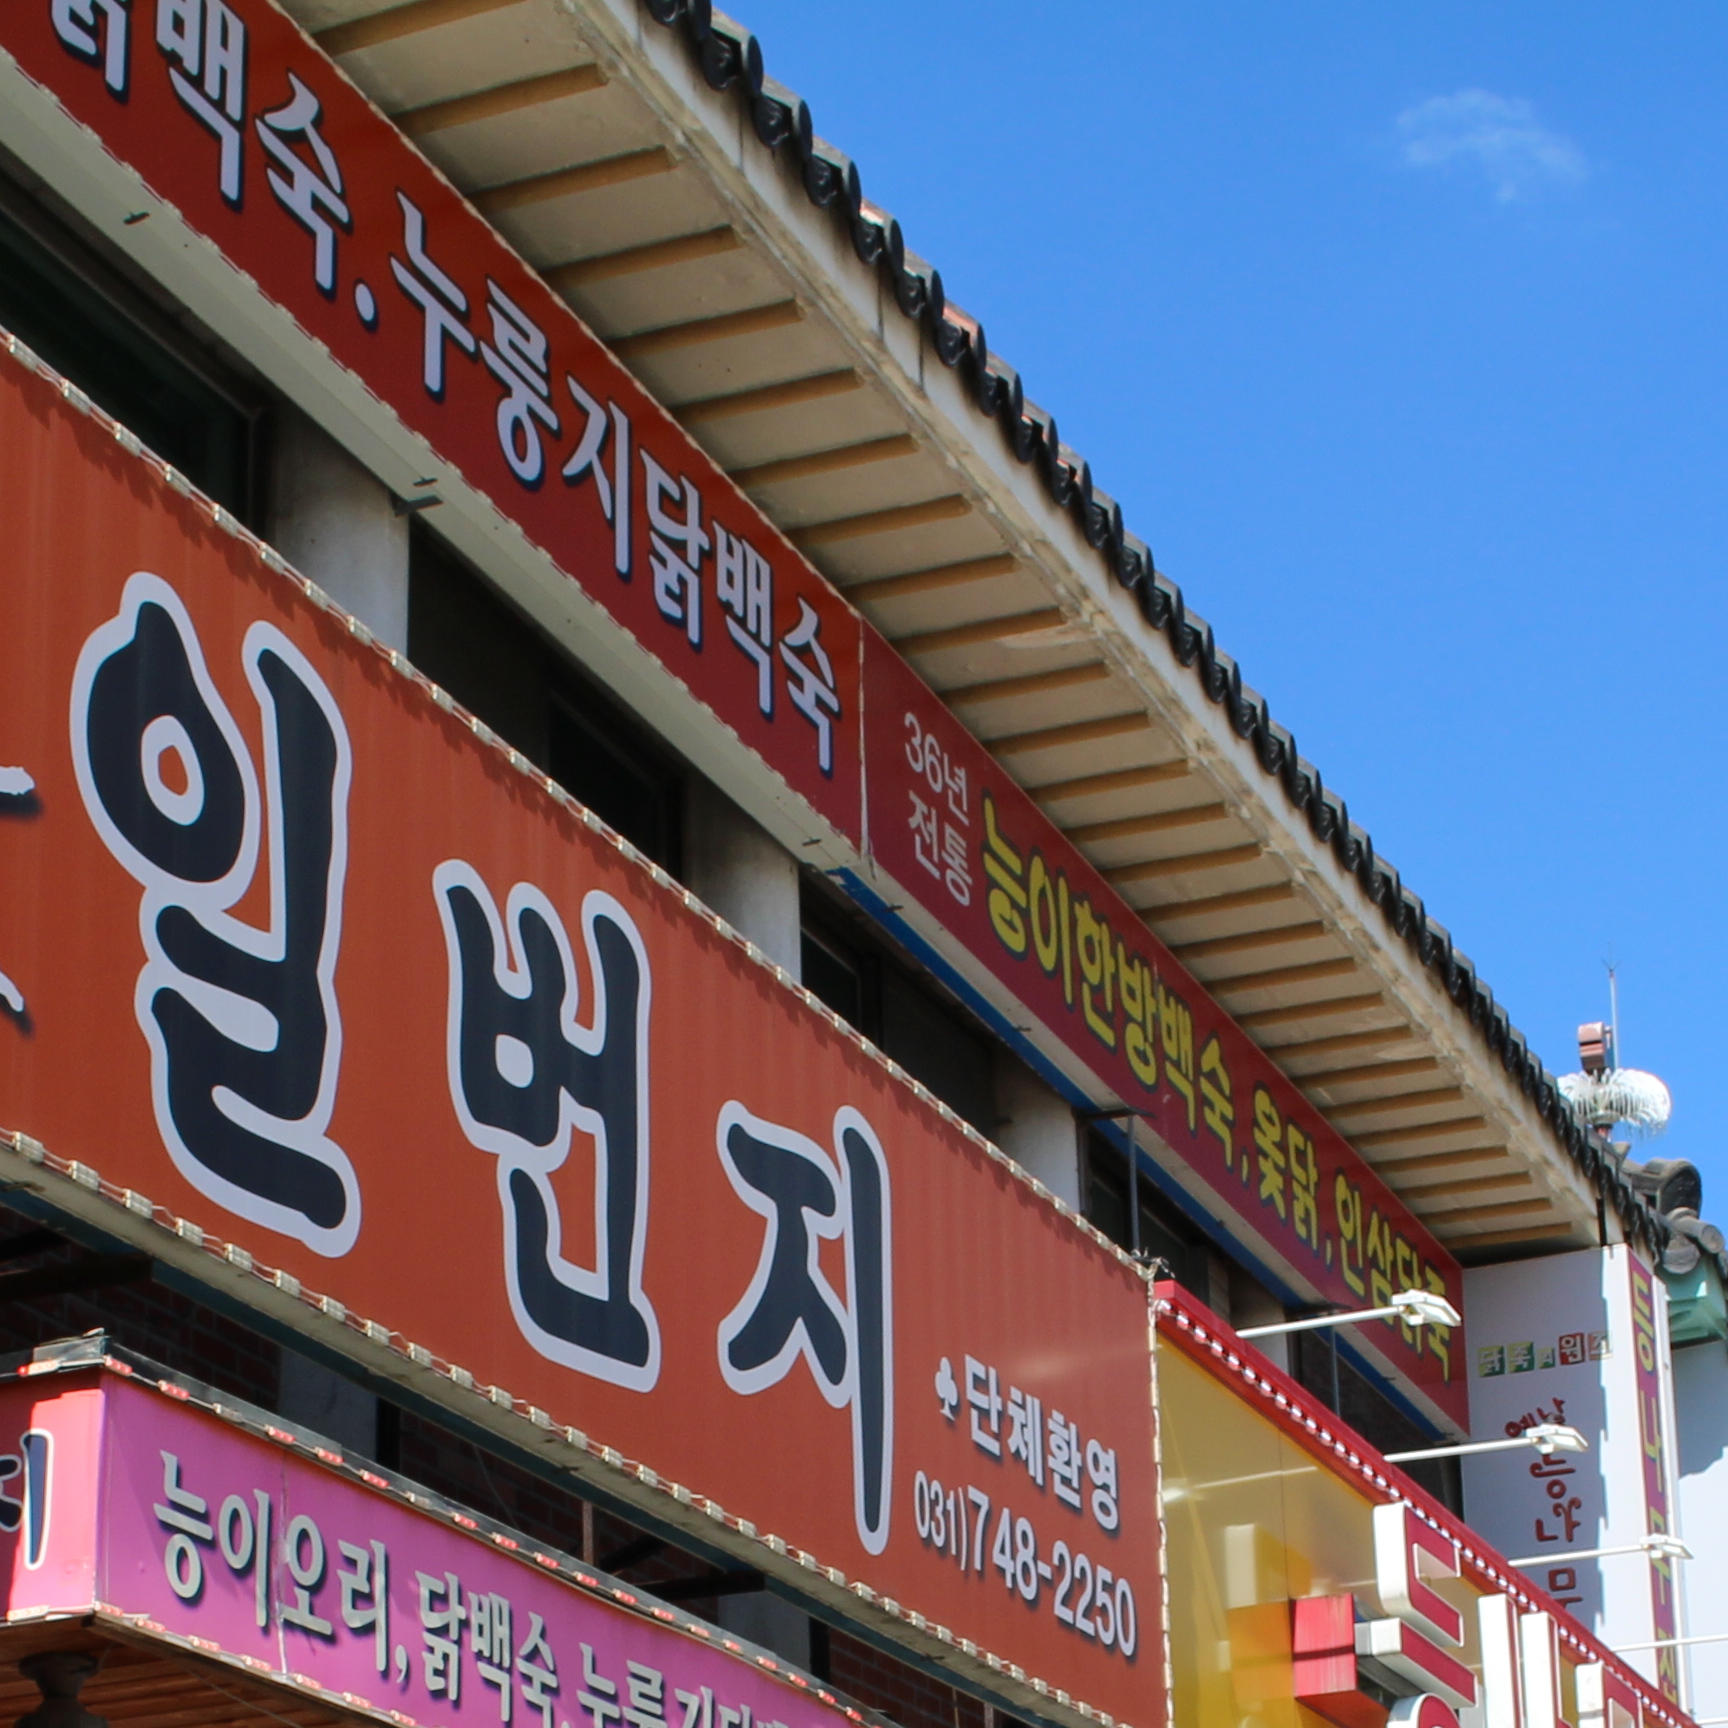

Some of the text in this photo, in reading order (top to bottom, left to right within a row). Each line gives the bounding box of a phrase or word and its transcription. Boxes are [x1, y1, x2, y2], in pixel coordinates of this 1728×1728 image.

[903, 711, 971, 824] 36년
[906, 790, 974, 908] 전통
[70, 568, 893, 1557] 일번지
[964, 1353, 1120, 1532] 단체환영
[913, 1469, 1136, 1658] 031)748-2250
